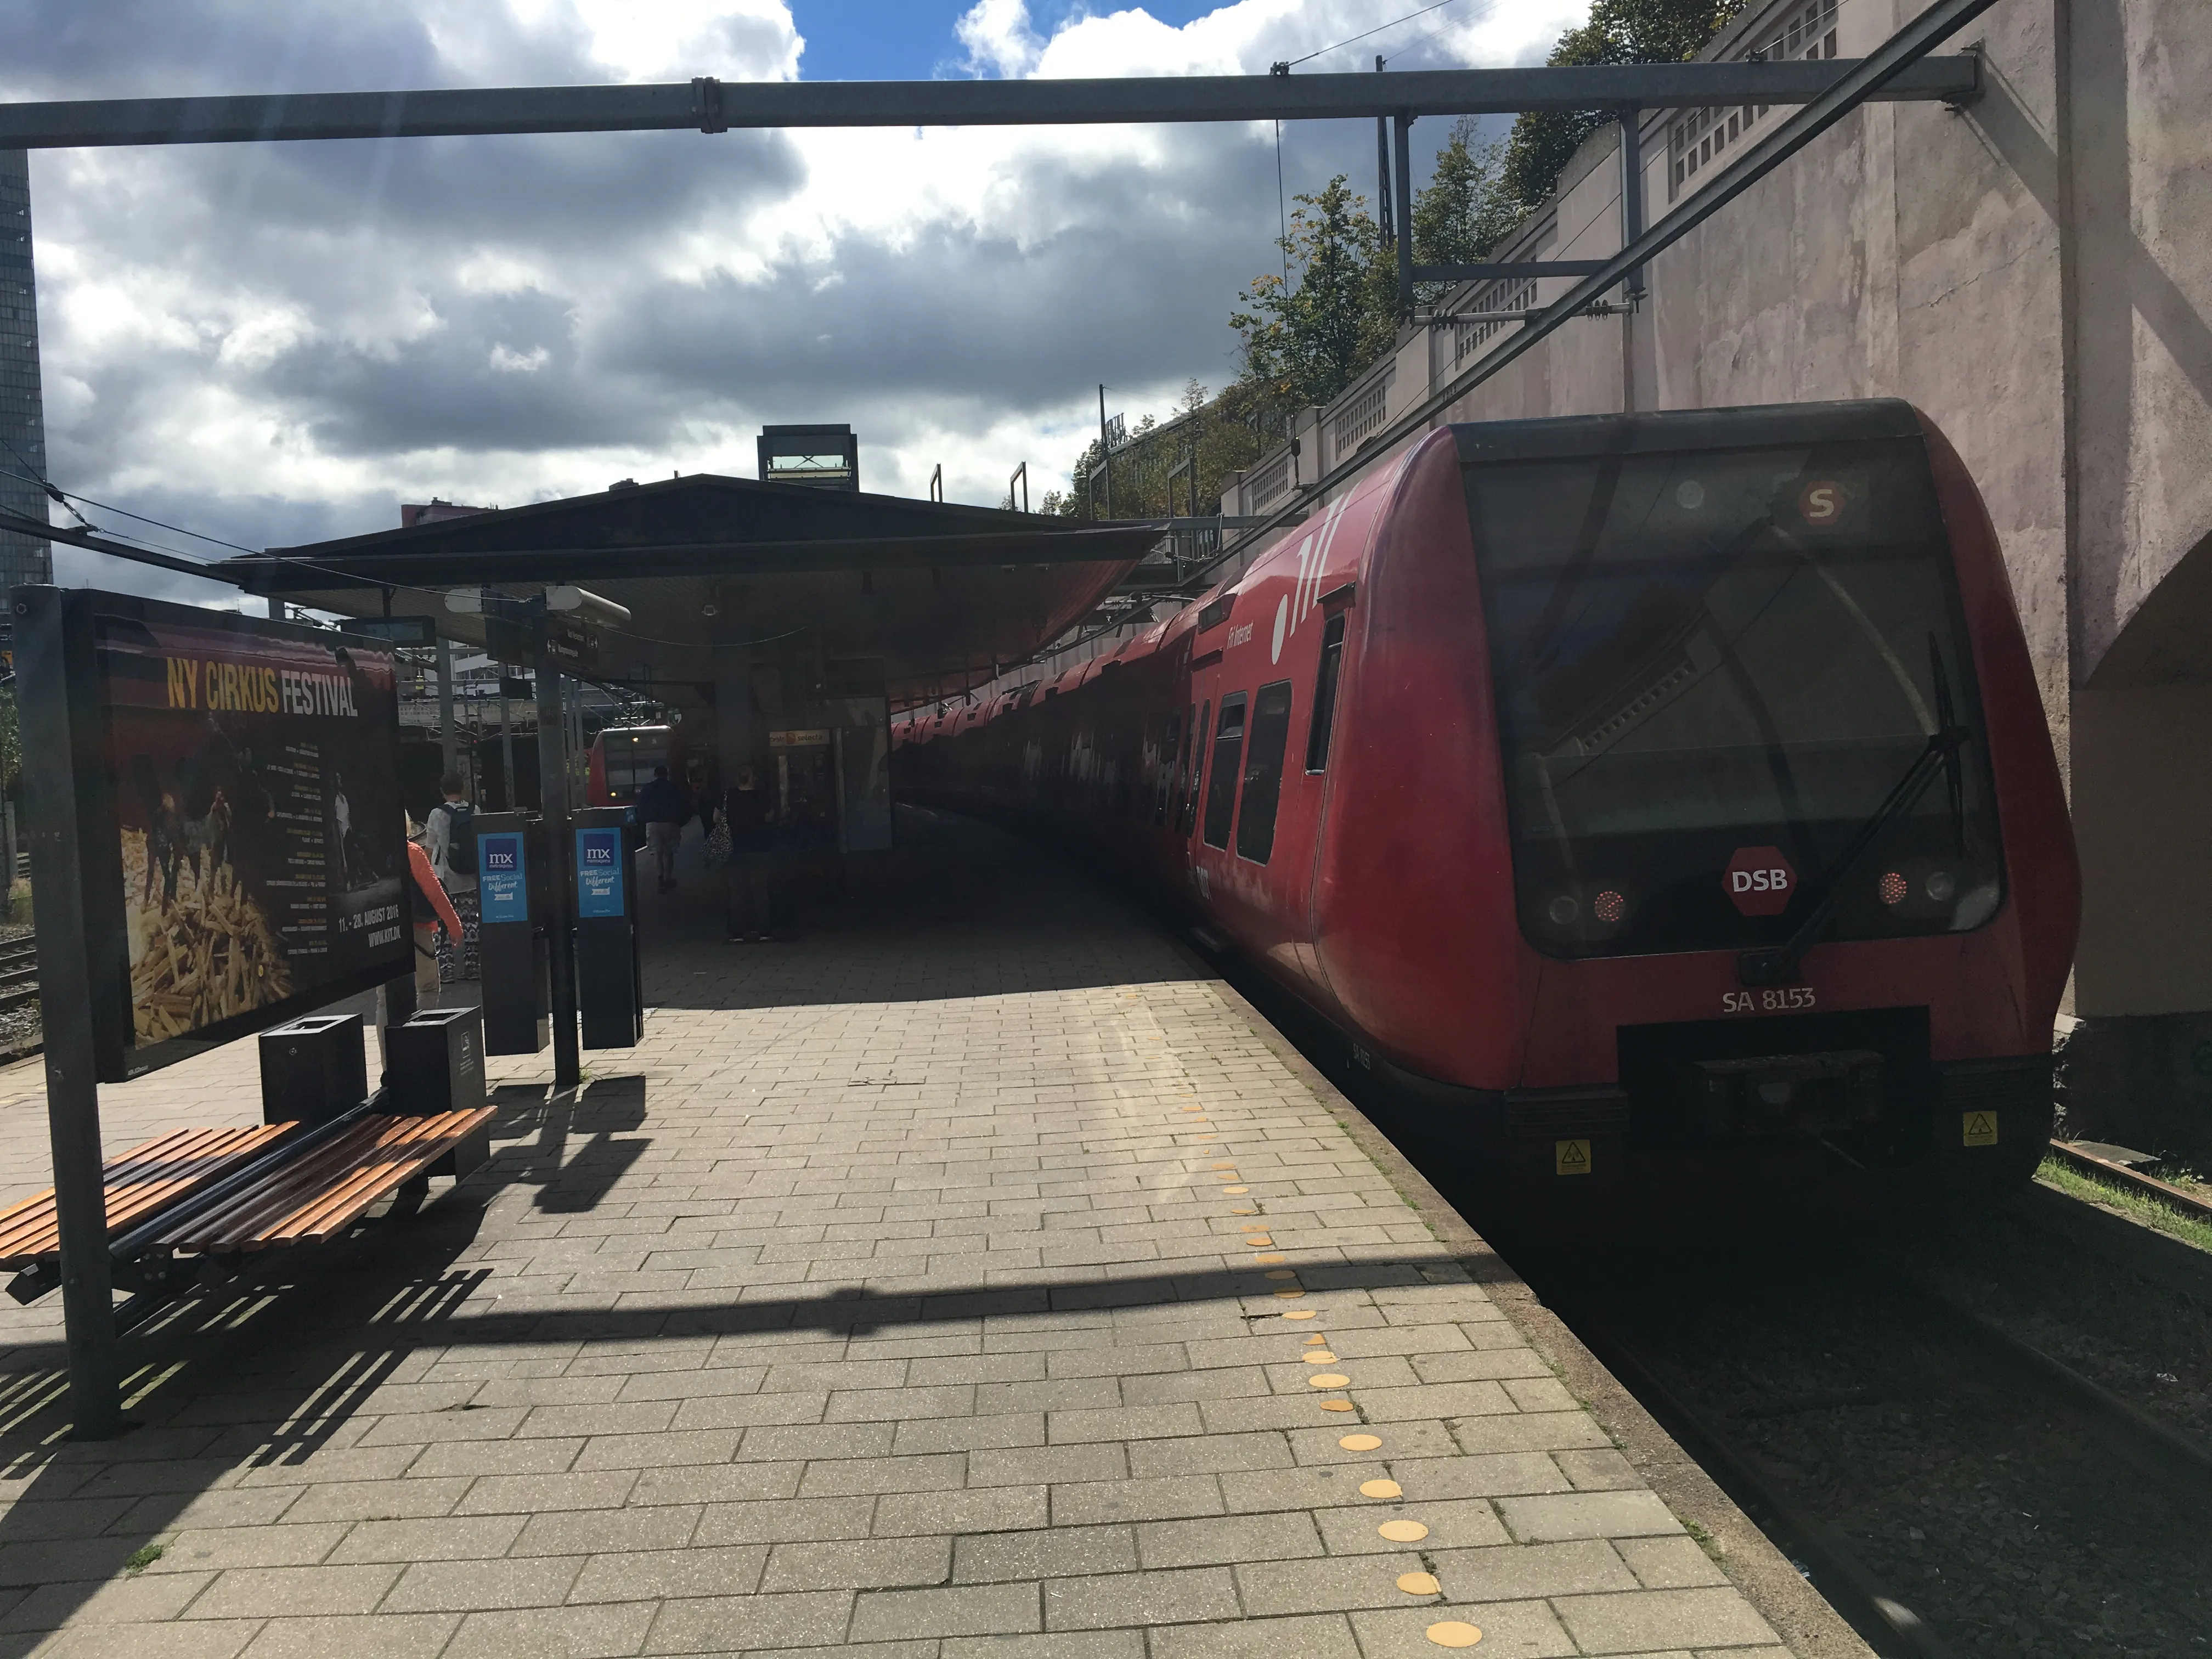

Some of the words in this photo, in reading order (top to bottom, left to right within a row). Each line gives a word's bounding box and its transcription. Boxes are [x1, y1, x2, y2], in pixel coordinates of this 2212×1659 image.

[1809, 488, 1834, 517] S
[167, 657, 198, 708] NY
[205, 661, 279, 713] CIRKUS
[280, 670, 358, 717] FESTIVAL
[489, 854, 513, 864] mx
[587, 849, 611, 859] mx
[501, 873, 523, 882] Social
[598, 867, 620, 876] Social
[488, 881, 518, 893] Different
[585, 876, 615, 887] Different
[1731, 869, 1788, 893] DSB
[353, 913, 363, 929] 28.
[364, 907, 385, 926] AUGUST
[386, 904, 399, 921] 2016
[1722, 991, 1755, 1013] SA
[1762, 987, 1816, 1011] 8153
